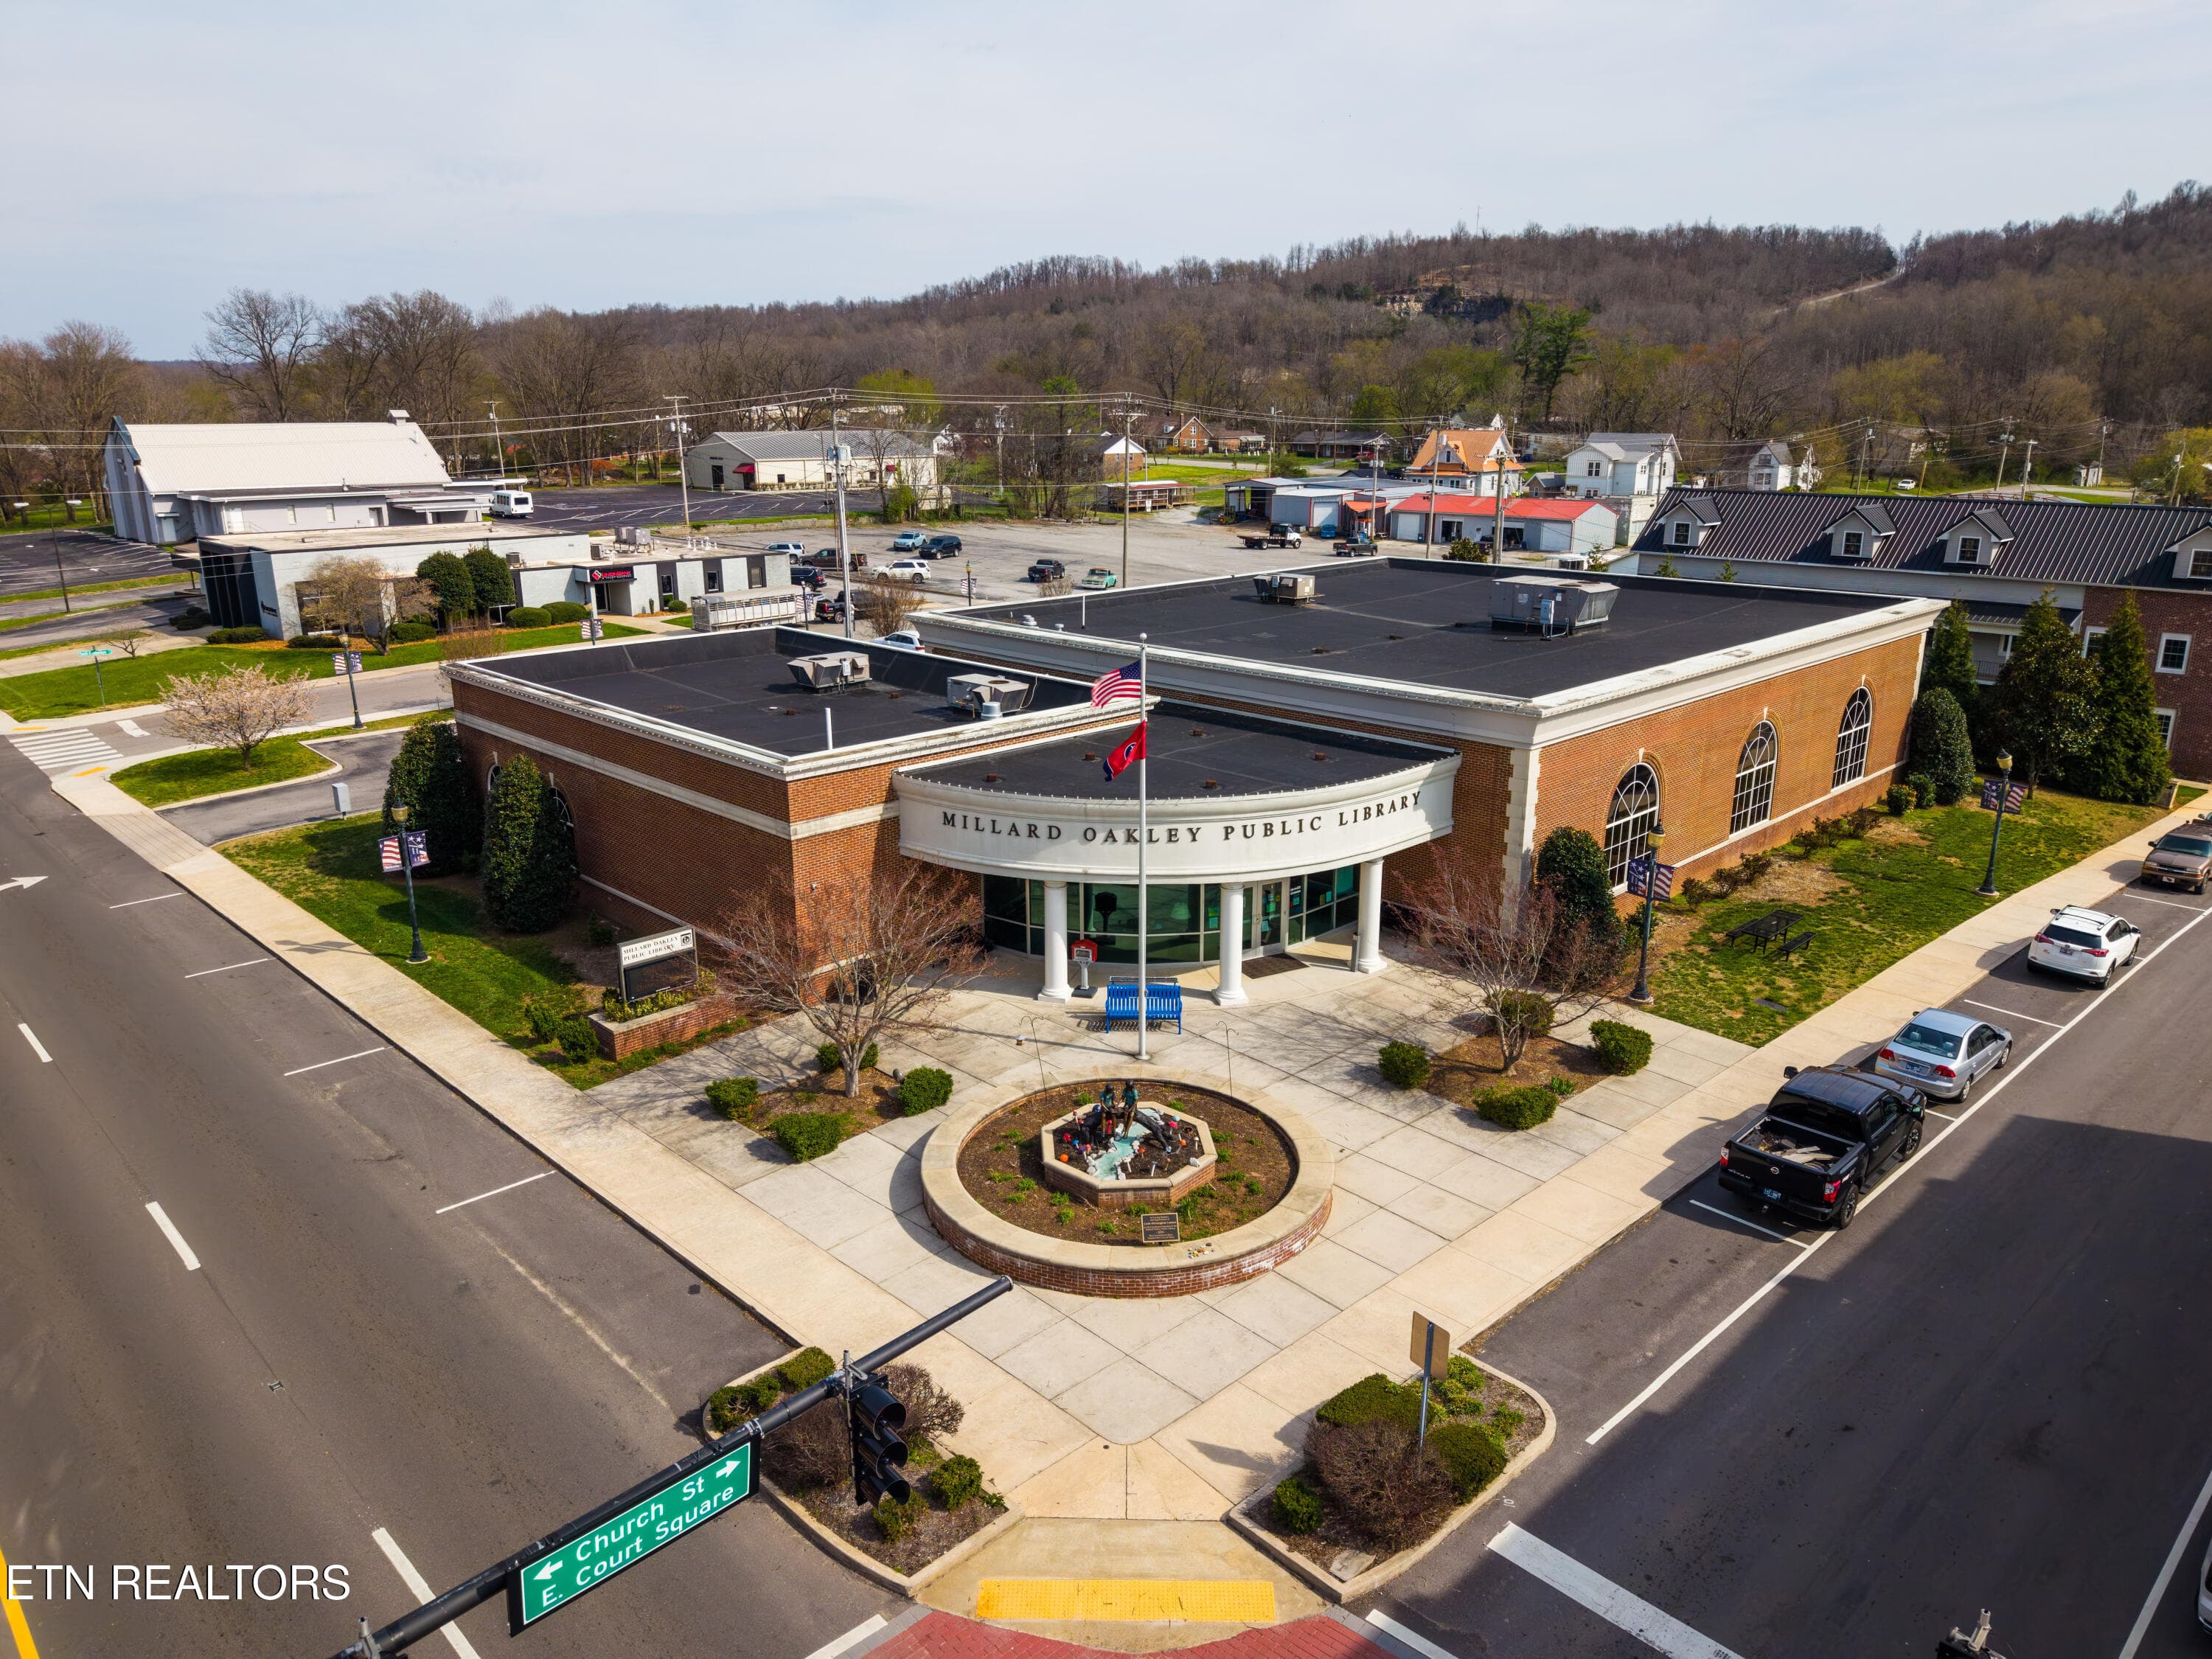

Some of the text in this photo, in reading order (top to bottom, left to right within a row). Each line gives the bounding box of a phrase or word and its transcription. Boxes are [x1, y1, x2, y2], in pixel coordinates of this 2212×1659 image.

[942, 790, 1421, 843] MILLARD OAKLEY PUBLIC LIBRARY
[624, 936, 678, 954] MILLARD OAKLEY
[624, 944, 675, 961] PUBLIC LIBRARY
[542, 1485, 734, 1607] E. Court Square
[576, 1477, 705, 1562] Church St
